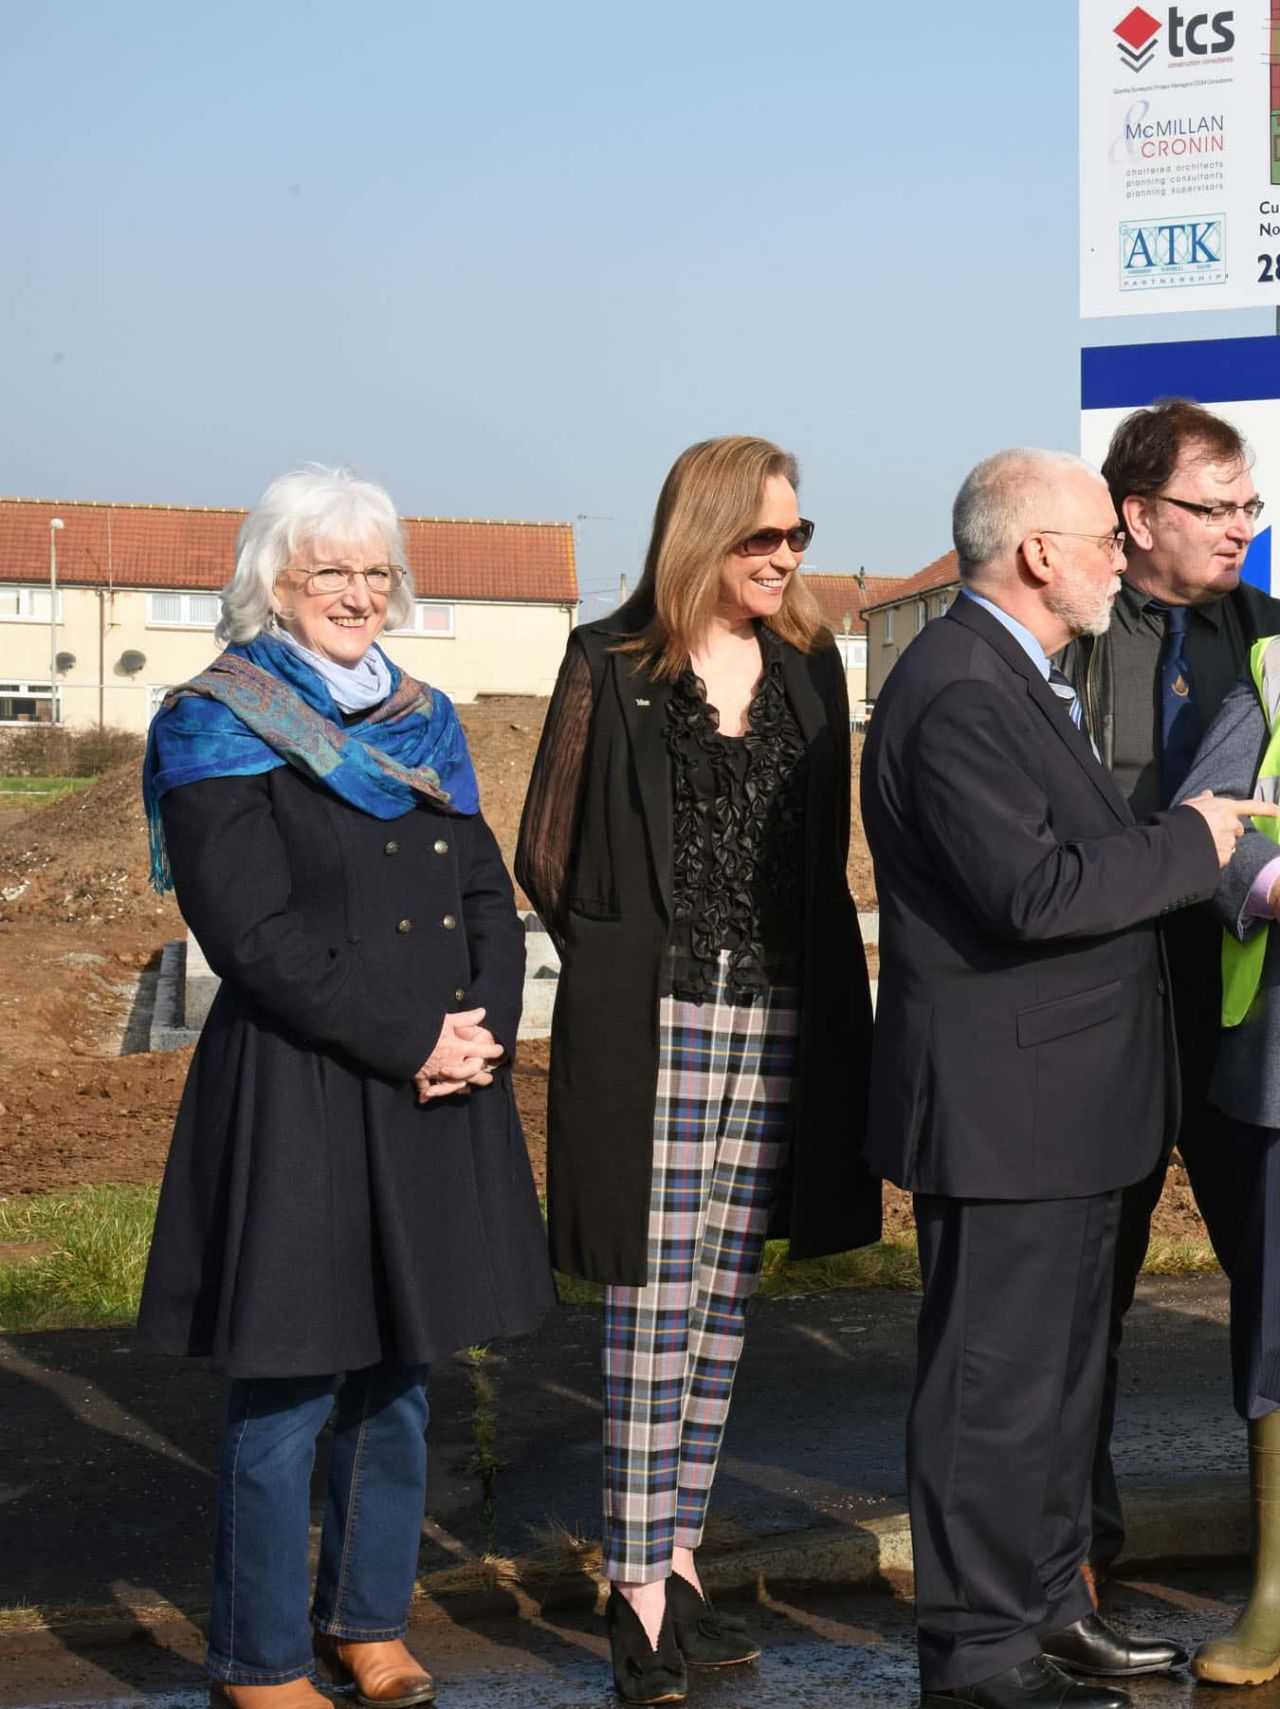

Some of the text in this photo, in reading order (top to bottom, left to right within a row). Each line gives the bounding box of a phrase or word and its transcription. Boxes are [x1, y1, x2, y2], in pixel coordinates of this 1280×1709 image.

[1168, 6, 1235, 57] tcs
[1126, 115, 1223, 140] McMILLAN
[1141, 135, 1223, 158] CRONIN
[1126, 160, 1224, 177] chartered architects
[1126, 171, 1223, 188] planning consultants
[1126, 182, 1223, 198] planning supervisors
[1124, 222, 1221, 269] ATK
